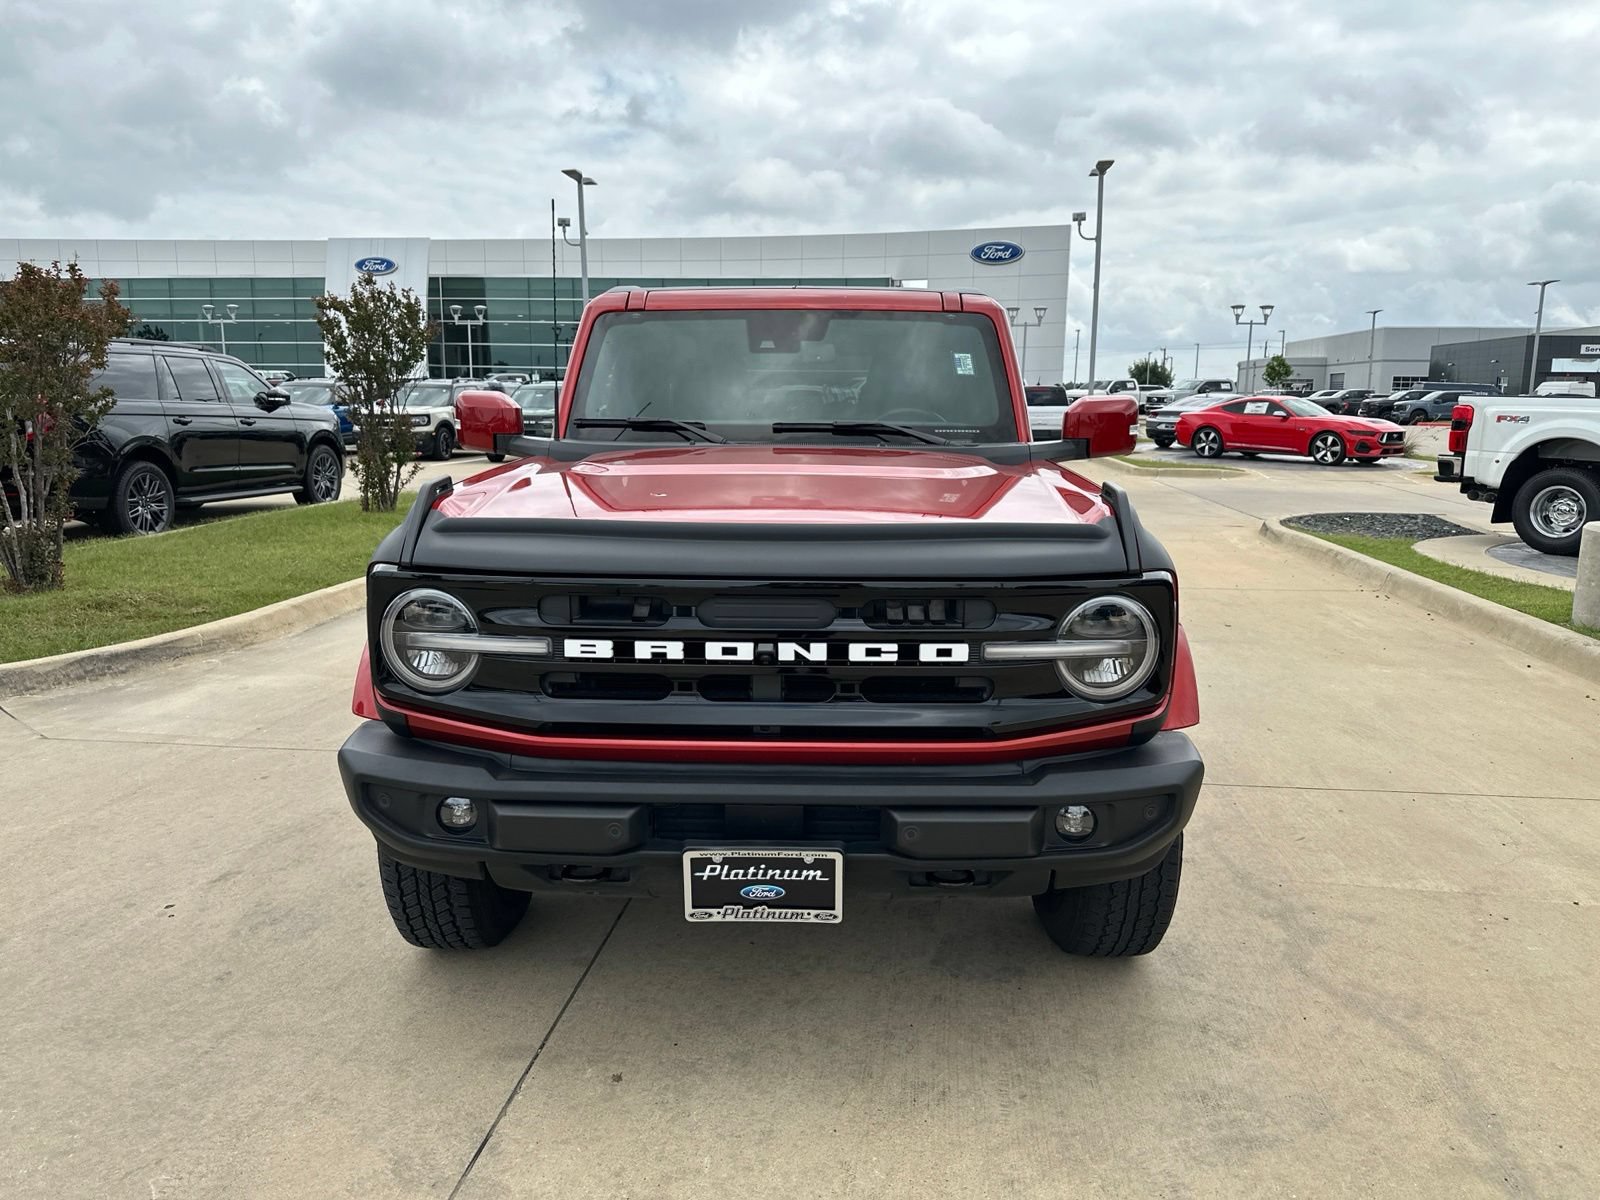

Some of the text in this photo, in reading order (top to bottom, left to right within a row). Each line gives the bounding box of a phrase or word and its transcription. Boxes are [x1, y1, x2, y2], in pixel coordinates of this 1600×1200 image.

[1496, 415, 1530, 424] FX4
[563, 638, 969, 664] BRONCO
[694, 864, 830, 881] Platinum
[722, 906, 811, 921] Platinum
